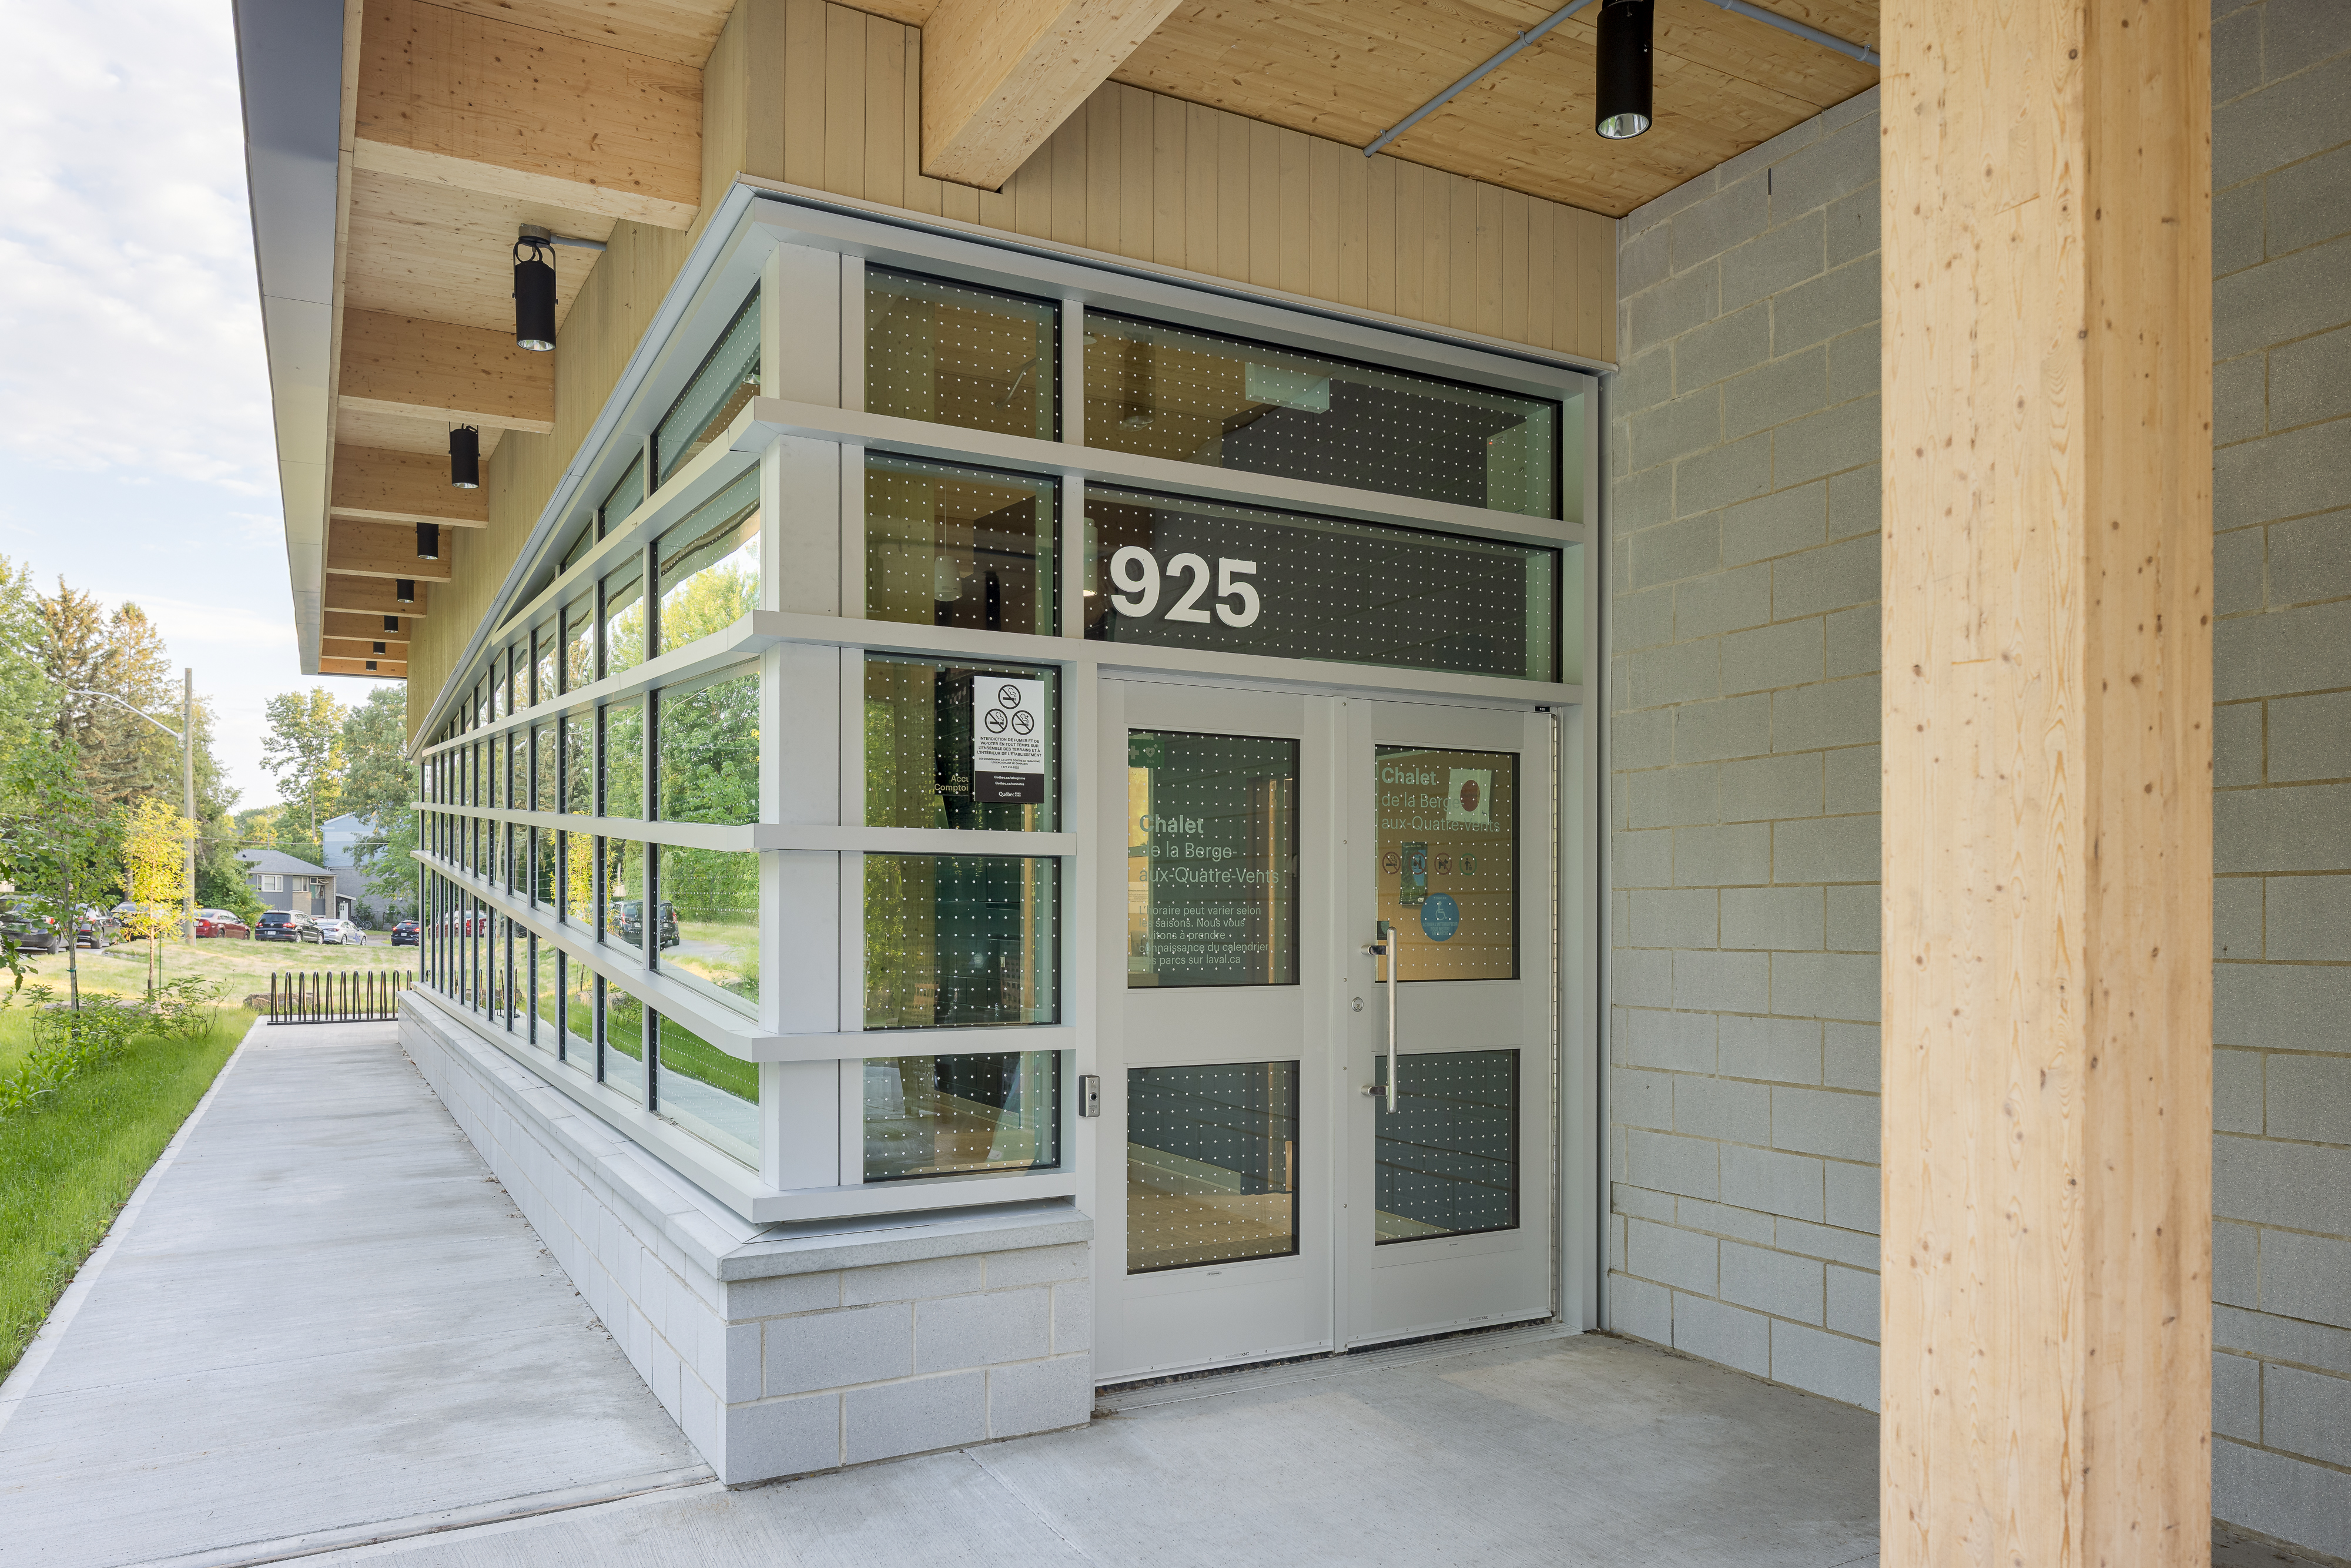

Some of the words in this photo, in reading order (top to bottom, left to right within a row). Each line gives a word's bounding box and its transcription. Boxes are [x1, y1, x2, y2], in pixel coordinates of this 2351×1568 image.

[1110, 545, 1260, 628] 925
[1382, 767, 1436, 786] Chalet
[1382, 791, 1399, 806] de
[1405, 792, 1415, 807] la
[1421, 793, 1465, 812] Berge-
[1139, 814, 1204, 833] Chalet
[1382, 816, 1500, 832] aux-Quatre-Vents
[1140, 840, 1160, 857] de
[1166, 841, 1179, 857] la
[1185, 842, 1237, 862] Berge-
[1139, 866, 1279, 884] aux-Quatre-Vents
[1183, 906, 1205, 917] peut
[1207, 906, 1234, 915] varier
[1237, 905, 1261, 915] selon
[1139, 918, 1153, 927] les
[1156, 918, 1193, 927] saisons.
[1197, 918, 1221, 927] Nous
[1139, 930, 1177, 940] invitons
[1180, 930, 1185, 940] à
[1188, 930, 1225, 942] prendre
[1139, 943, 1205, 952] connaissance
[1207, 942, 1220, 951] du
[1223, 942, 1269, 951] calendrier
[1160, 957, 1186, 967] parcs
[1206, 954, 1240, 964] laval.ca
